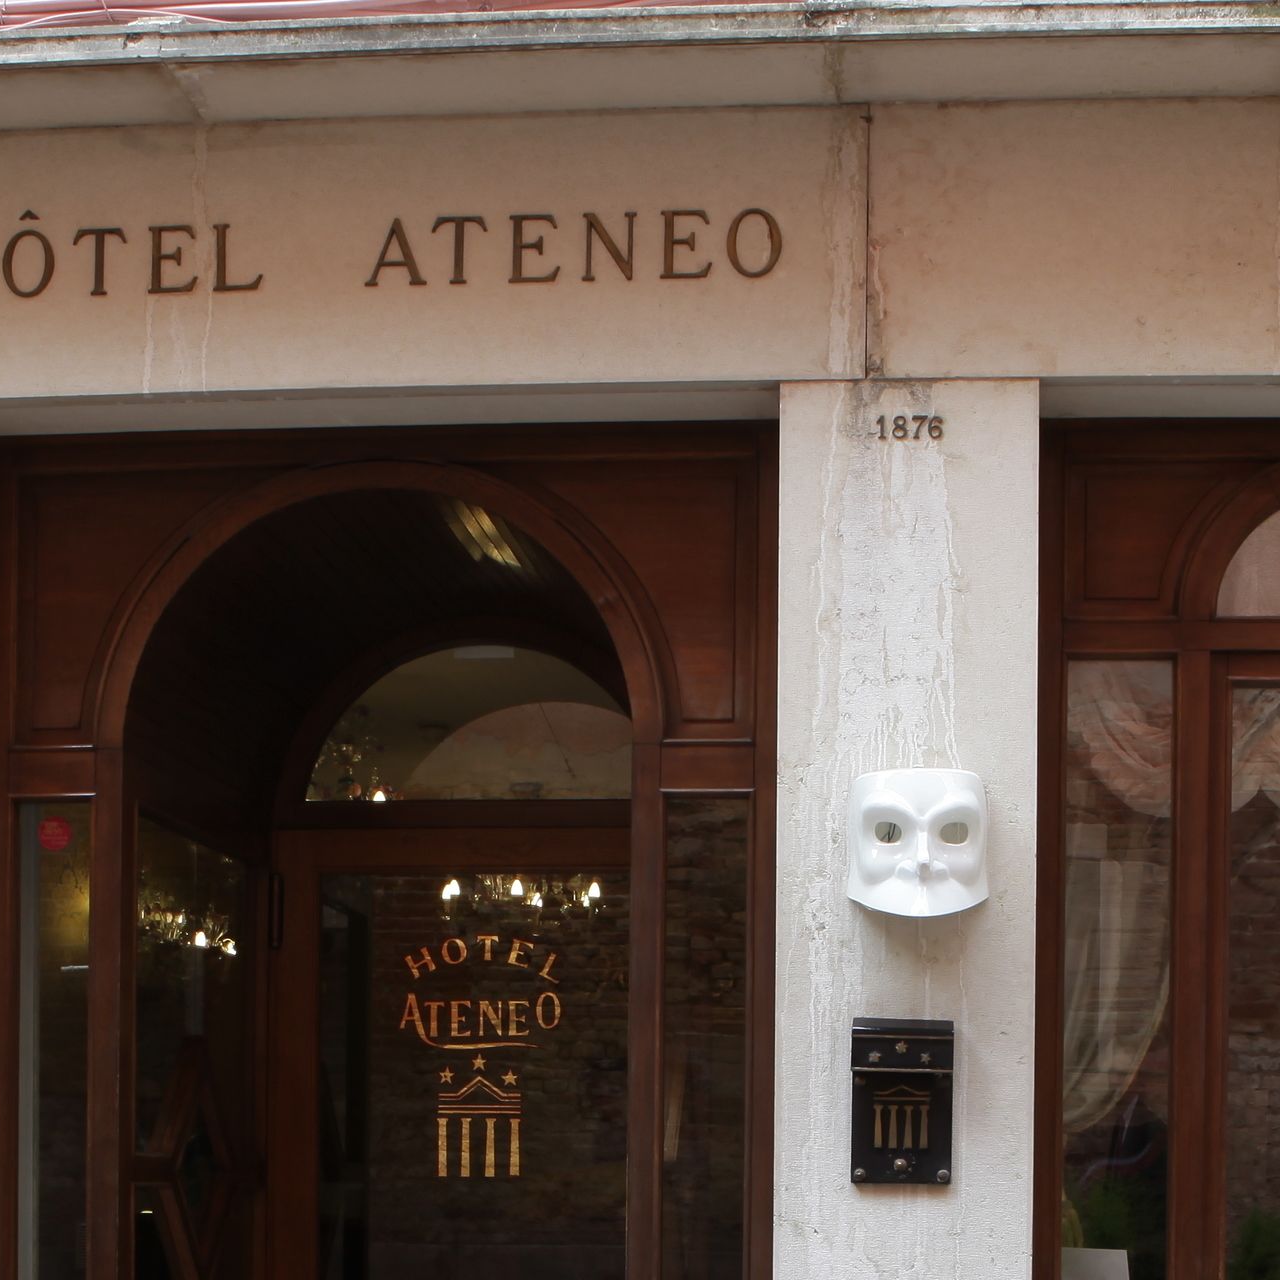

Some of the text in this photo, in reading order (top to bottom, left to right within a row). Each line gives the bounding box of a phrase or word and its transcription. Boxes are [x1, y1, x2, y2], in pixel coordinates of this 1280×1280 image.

[364, 207, 784, 288] ATENEO
[875, 414, 944, 441] 1876
[404, 935, 561, 984] HOTEL
[399, 991, 562, 1049] ATENEO
